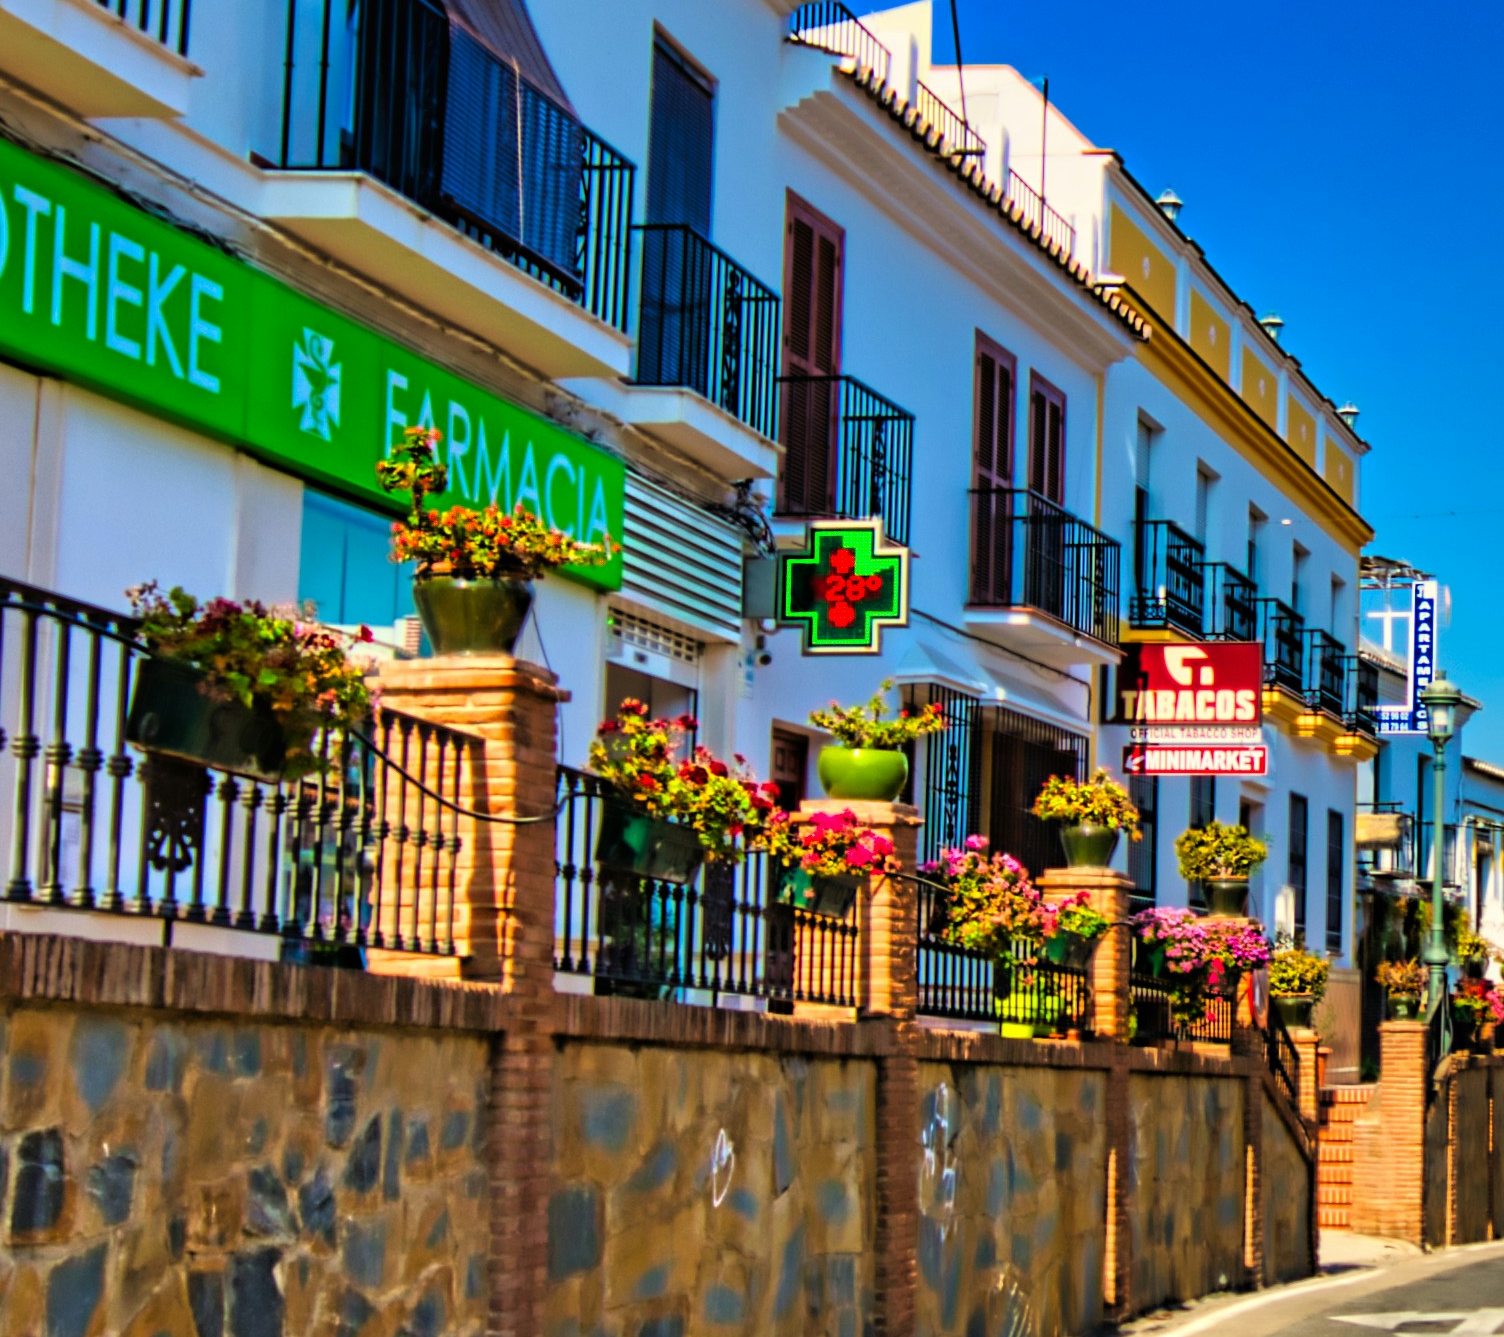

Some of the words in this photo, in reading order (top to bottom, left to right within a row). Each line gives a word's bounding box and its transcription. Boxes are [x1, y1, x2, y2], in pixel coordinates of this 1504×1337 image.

[384, 367, 613, 561] FARMACIA
[1121, 689, 1257, 721] TABACOS
[1130, 727, 1177, 739] OFFICIAL
[1180, 727, 1227, 739] TABACCO
[1231, 727, 1258, 739] SHOP
[1145, 748, 1264, 771] MINIMARKET
